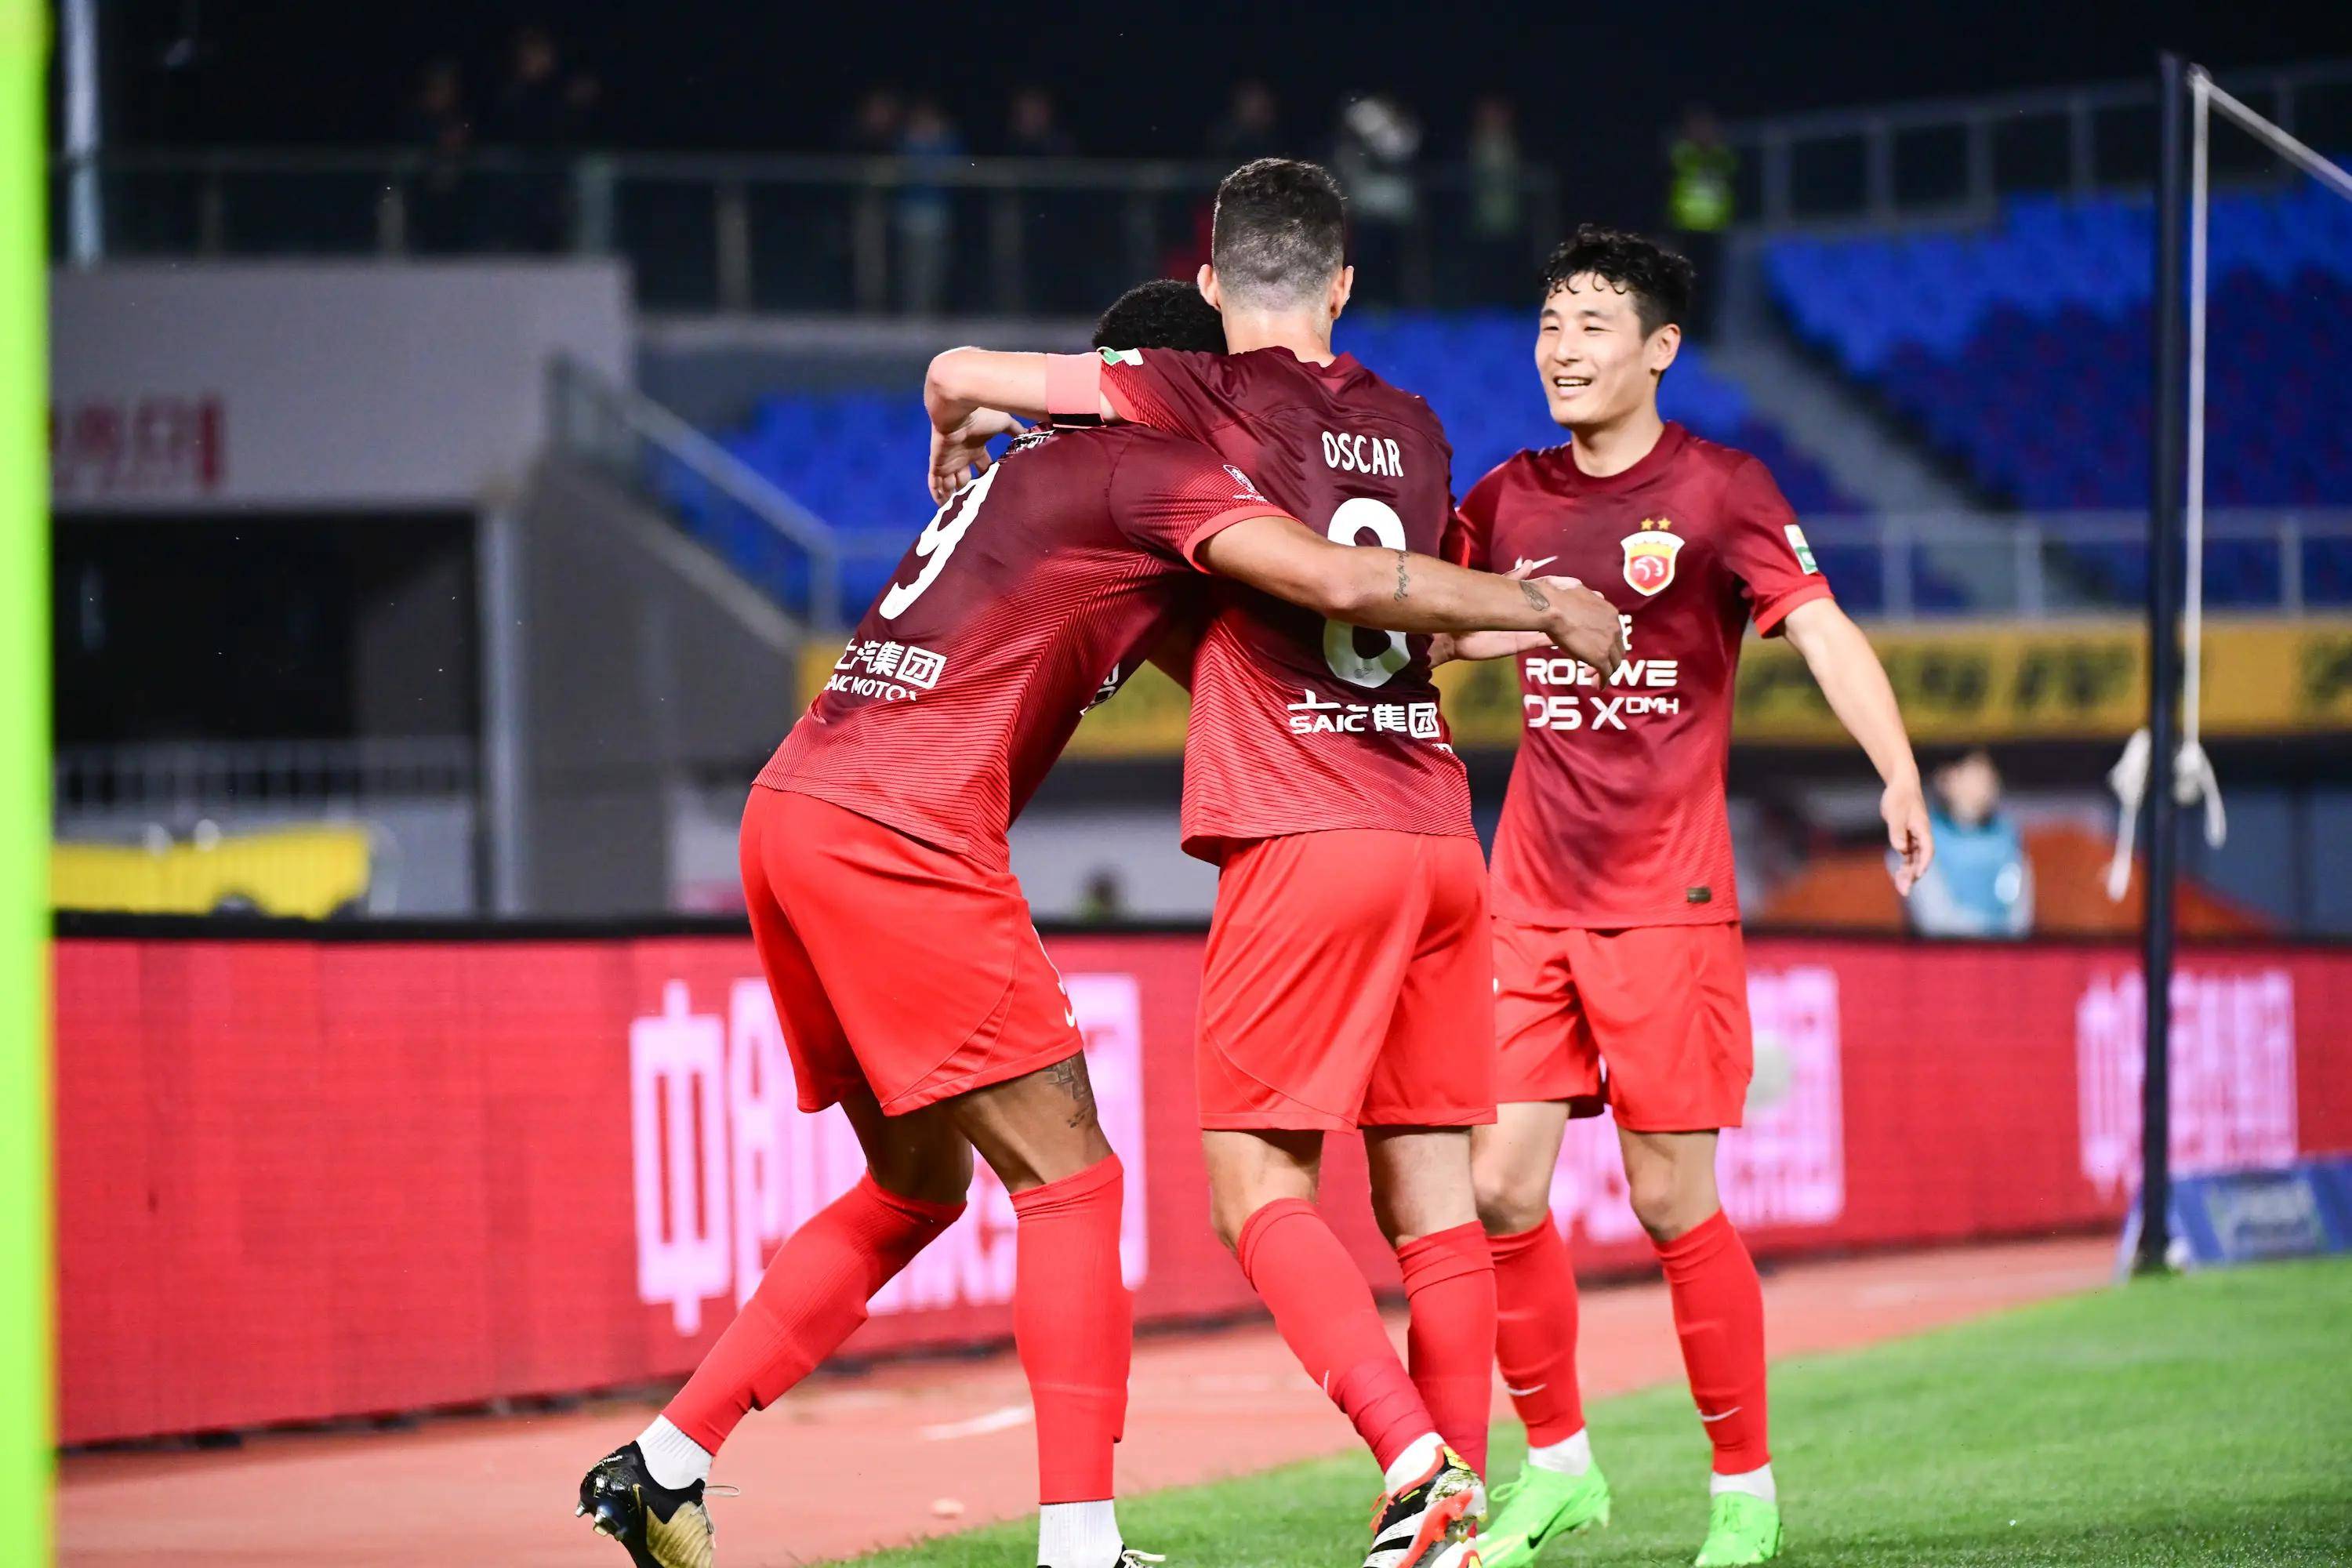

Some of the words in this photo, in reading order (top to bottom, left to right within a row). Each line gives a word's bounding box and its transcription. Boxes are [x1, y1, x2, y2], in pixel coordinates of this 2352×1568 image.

[1322, 430, 1403, 477] OSCAR
[879, 462, 1000, 620] 9
[1323, 497, 1410, 688] 8
[824, 673, 854, 692] AIC
[1289, 714, 1367, 735] SAIC
